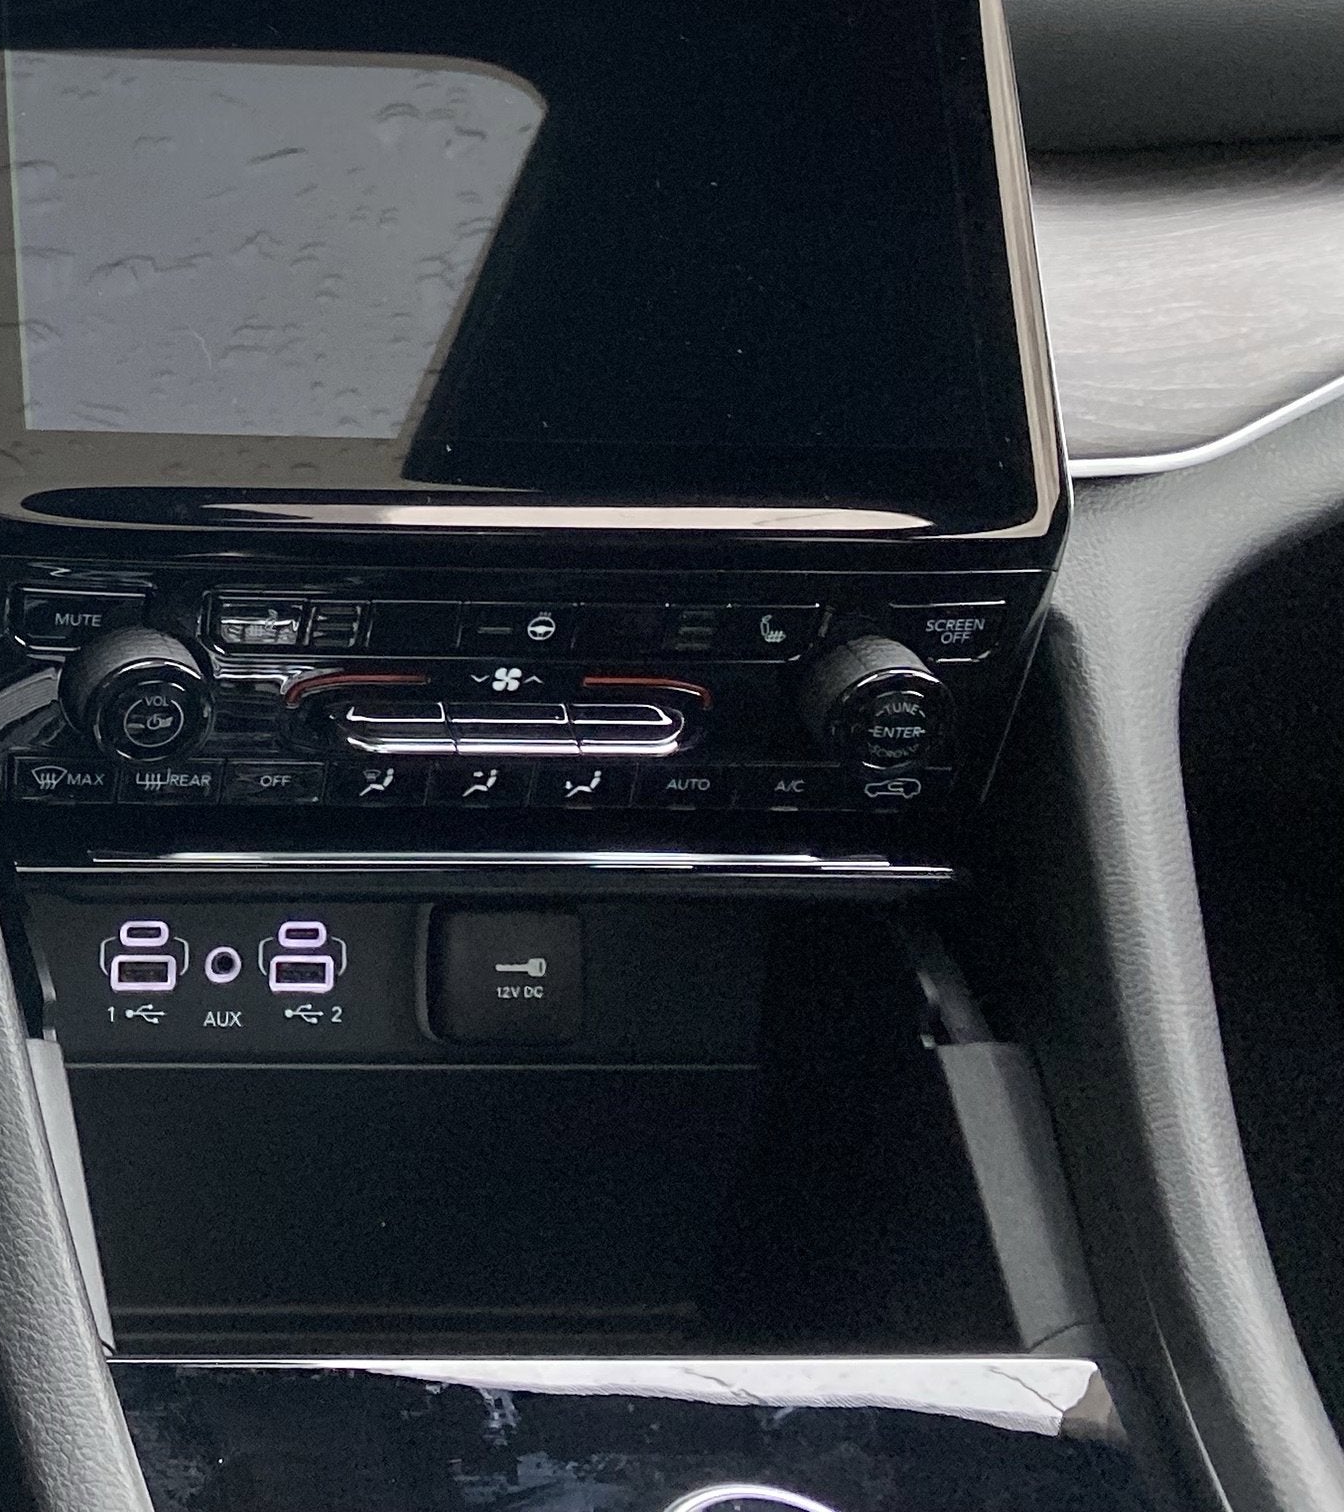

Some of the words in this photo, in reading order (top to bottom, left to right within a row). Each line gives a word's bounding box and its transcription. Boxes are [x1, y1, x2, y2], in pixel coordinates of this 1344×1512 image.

[55, 613, 103, 627] MUTE
[925, 618, 986, 632] SCREEN
[940, 631, 973, 645] OFF
[144, 696, 170, 708] VOL
[883, 701, 920, 716] TUNE
[872, 725, 922, 739] ENTER
[66, 774, 106, 786] MAX
[169, 774, 212, 787] REAR
[259, 775, 292, 787] OFF
[665, 778, 711, 791] AUTO
[774, 779, 806, 793] A/C
[496, 986, 521, 998] 12V
[523, 985, 544, 999] DC
[107, 1006, 115, 1023] 1
[202, 1011, 243, 1028] AUX
[330, 1006, 343, 1023] 2
